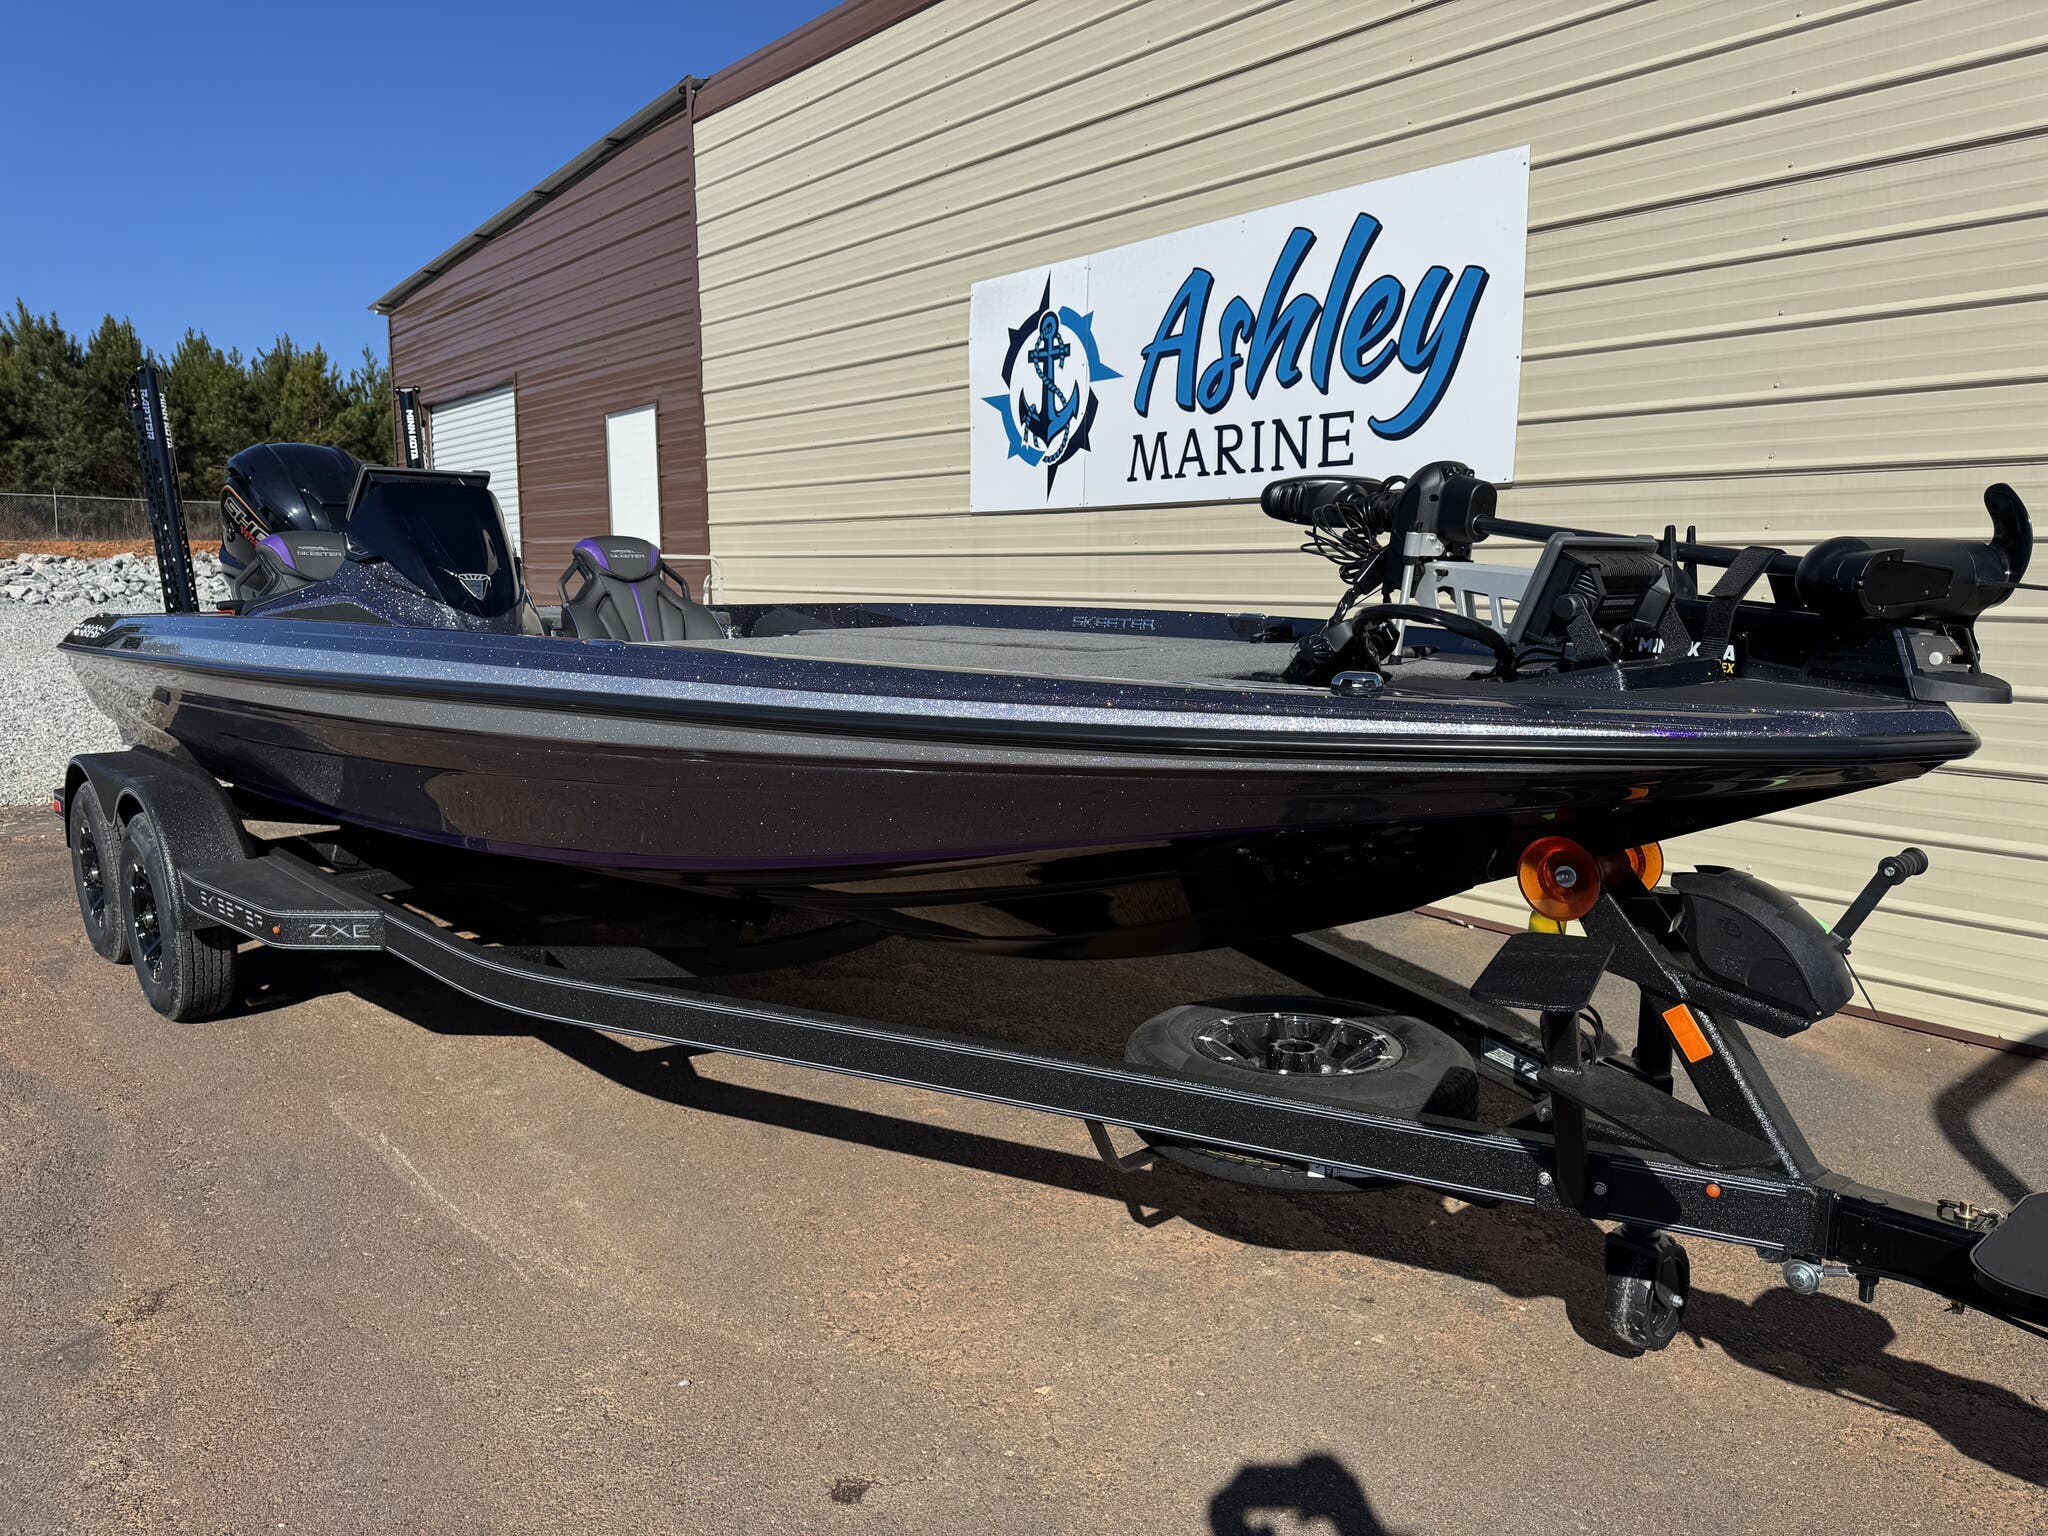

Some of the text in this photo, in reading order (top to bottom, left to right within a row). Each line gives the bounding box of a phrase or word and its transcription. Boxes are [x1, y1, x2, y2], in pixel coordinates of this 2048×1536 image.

[1134, 212, 1490, 441] Ashley
[140, 388, 155, 440] RAPTOR
[159, 392, 174, 449] MINN KOTA
[405, 409, 420, 461] MINN KOTA
[1127, 410, 1355, 482] MARINE
[1072, 616, 1156, 631] SKEETER
[1687, 641, 1736, 662] KA
[200, 890, 263, 928] SKEETER
[309, 923, 371, 938] ZXE
